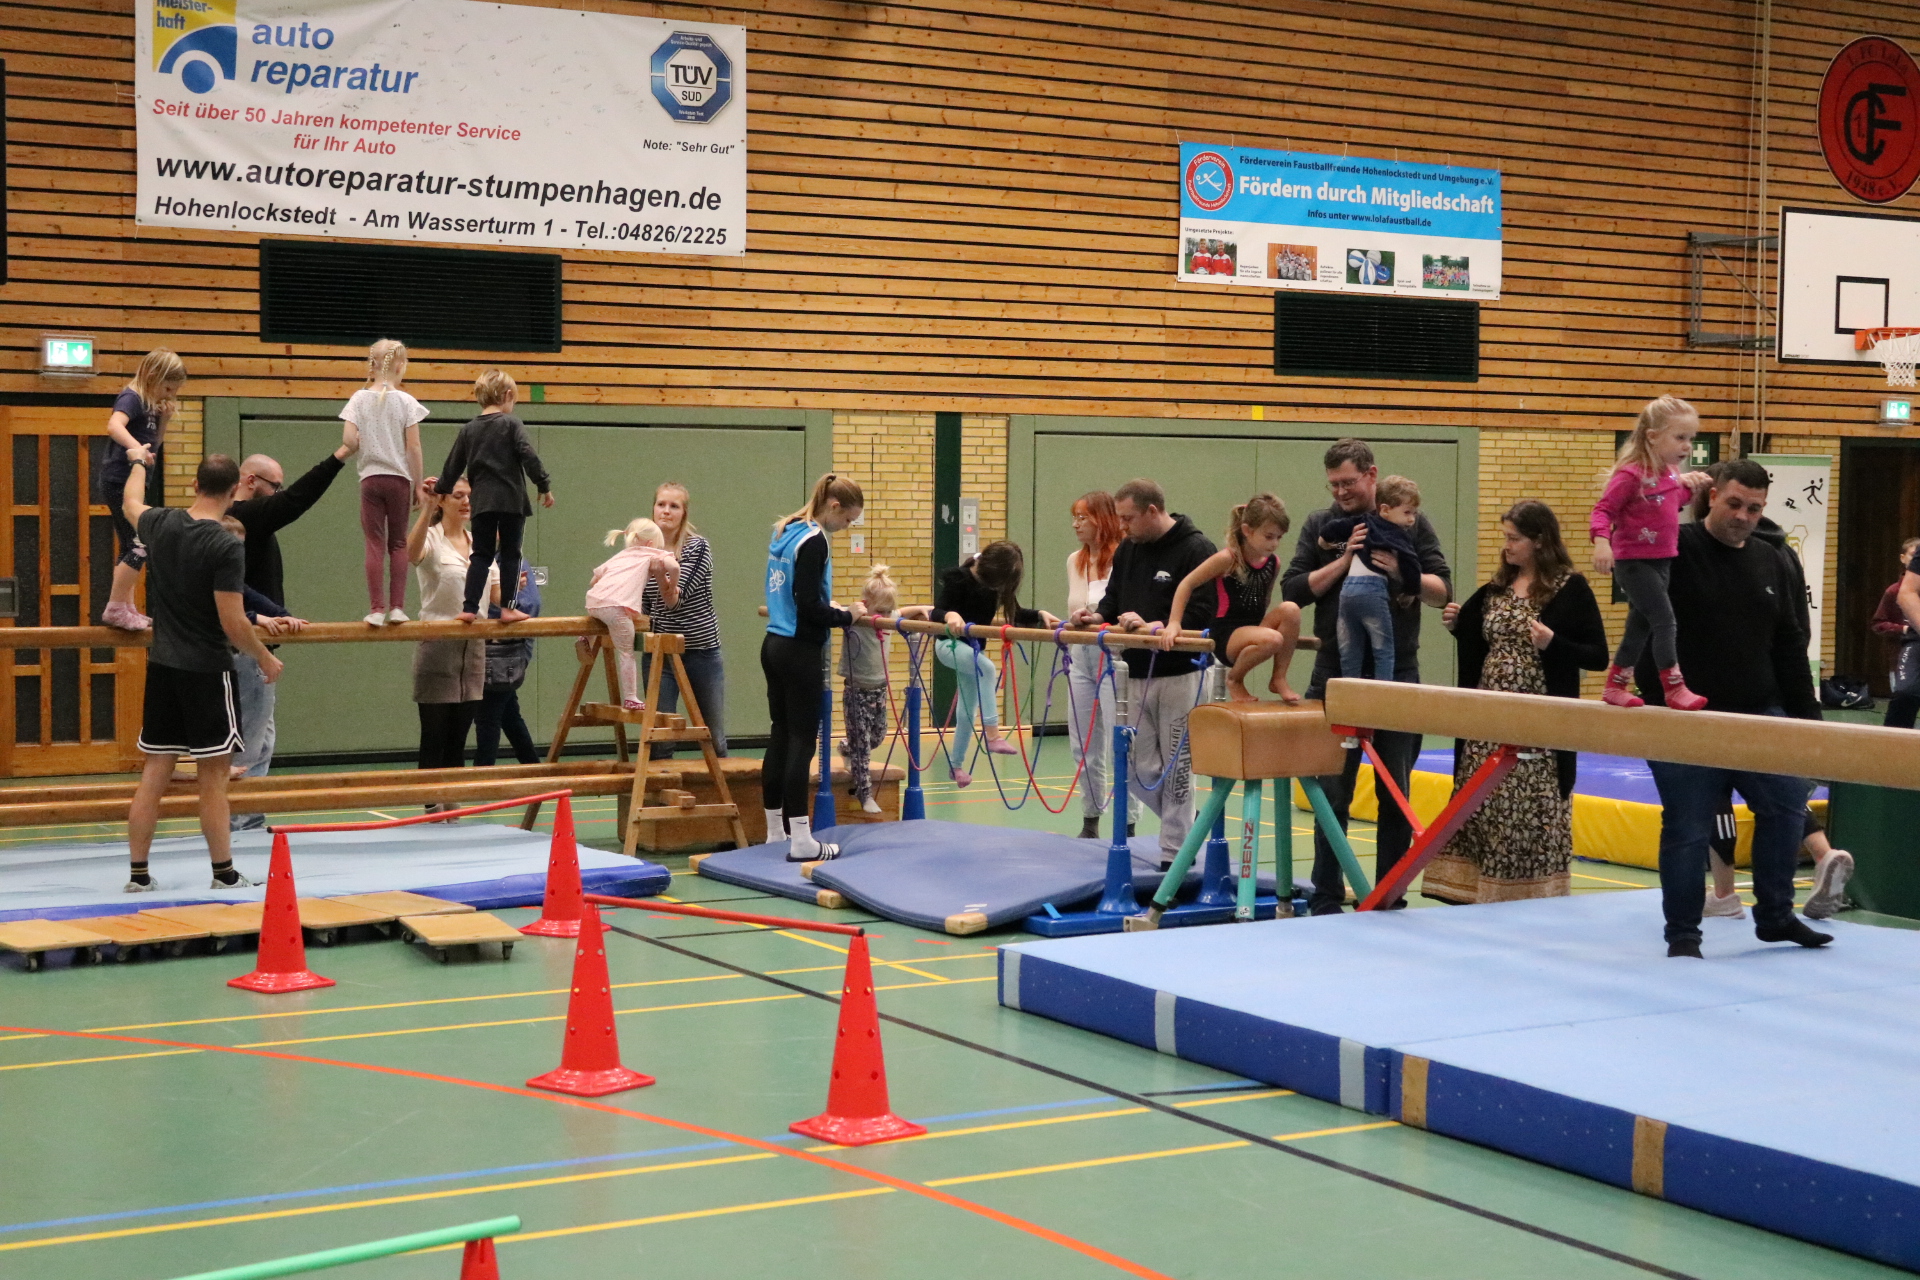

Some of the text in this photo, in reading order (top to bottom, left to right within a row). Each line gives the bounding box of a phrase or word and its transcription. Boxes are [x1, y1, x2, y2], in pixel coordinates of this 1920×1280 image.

[157, 11, 185, 30] haft
[252, 22, 334, 50] auto
[251, 58, 419, 94] reparatur
[670, 64, 712, 86] TÜV
[682, 91, 702, 102] SÜD
[153, 99, 521, 141] Seit über 50 Jahren kompetenter Service
[294, 133, 396, 155] für Ihr Auto
[643, 139, 735, 155] Note: "Sehr Gut"
[1240, 155, 1494, 186] Förderverein Faustballfreunde Hohenlockstedt und Umgebung e.V.
[1845, 170, 1876, 197] 1948
[157, 158, 722, 213] www.autoreparatur-stumpenhagen.de
[1239, 175, 1494, 214] Fördern durch Mitgliedschaft
[155, 196, 336, 225] Hohenlockstedt
[363, 209, 399, 229] Am
[408, 211, 535, 236] Wasserturm
[542, 218, 553, 237] 1
[576, 221, 727, 246] Tel.:04826/2225
[1308, 209, 1432, 227] Infos unter www.lolafaustball.de
[1241, 821, 1255, 879] BENZ
